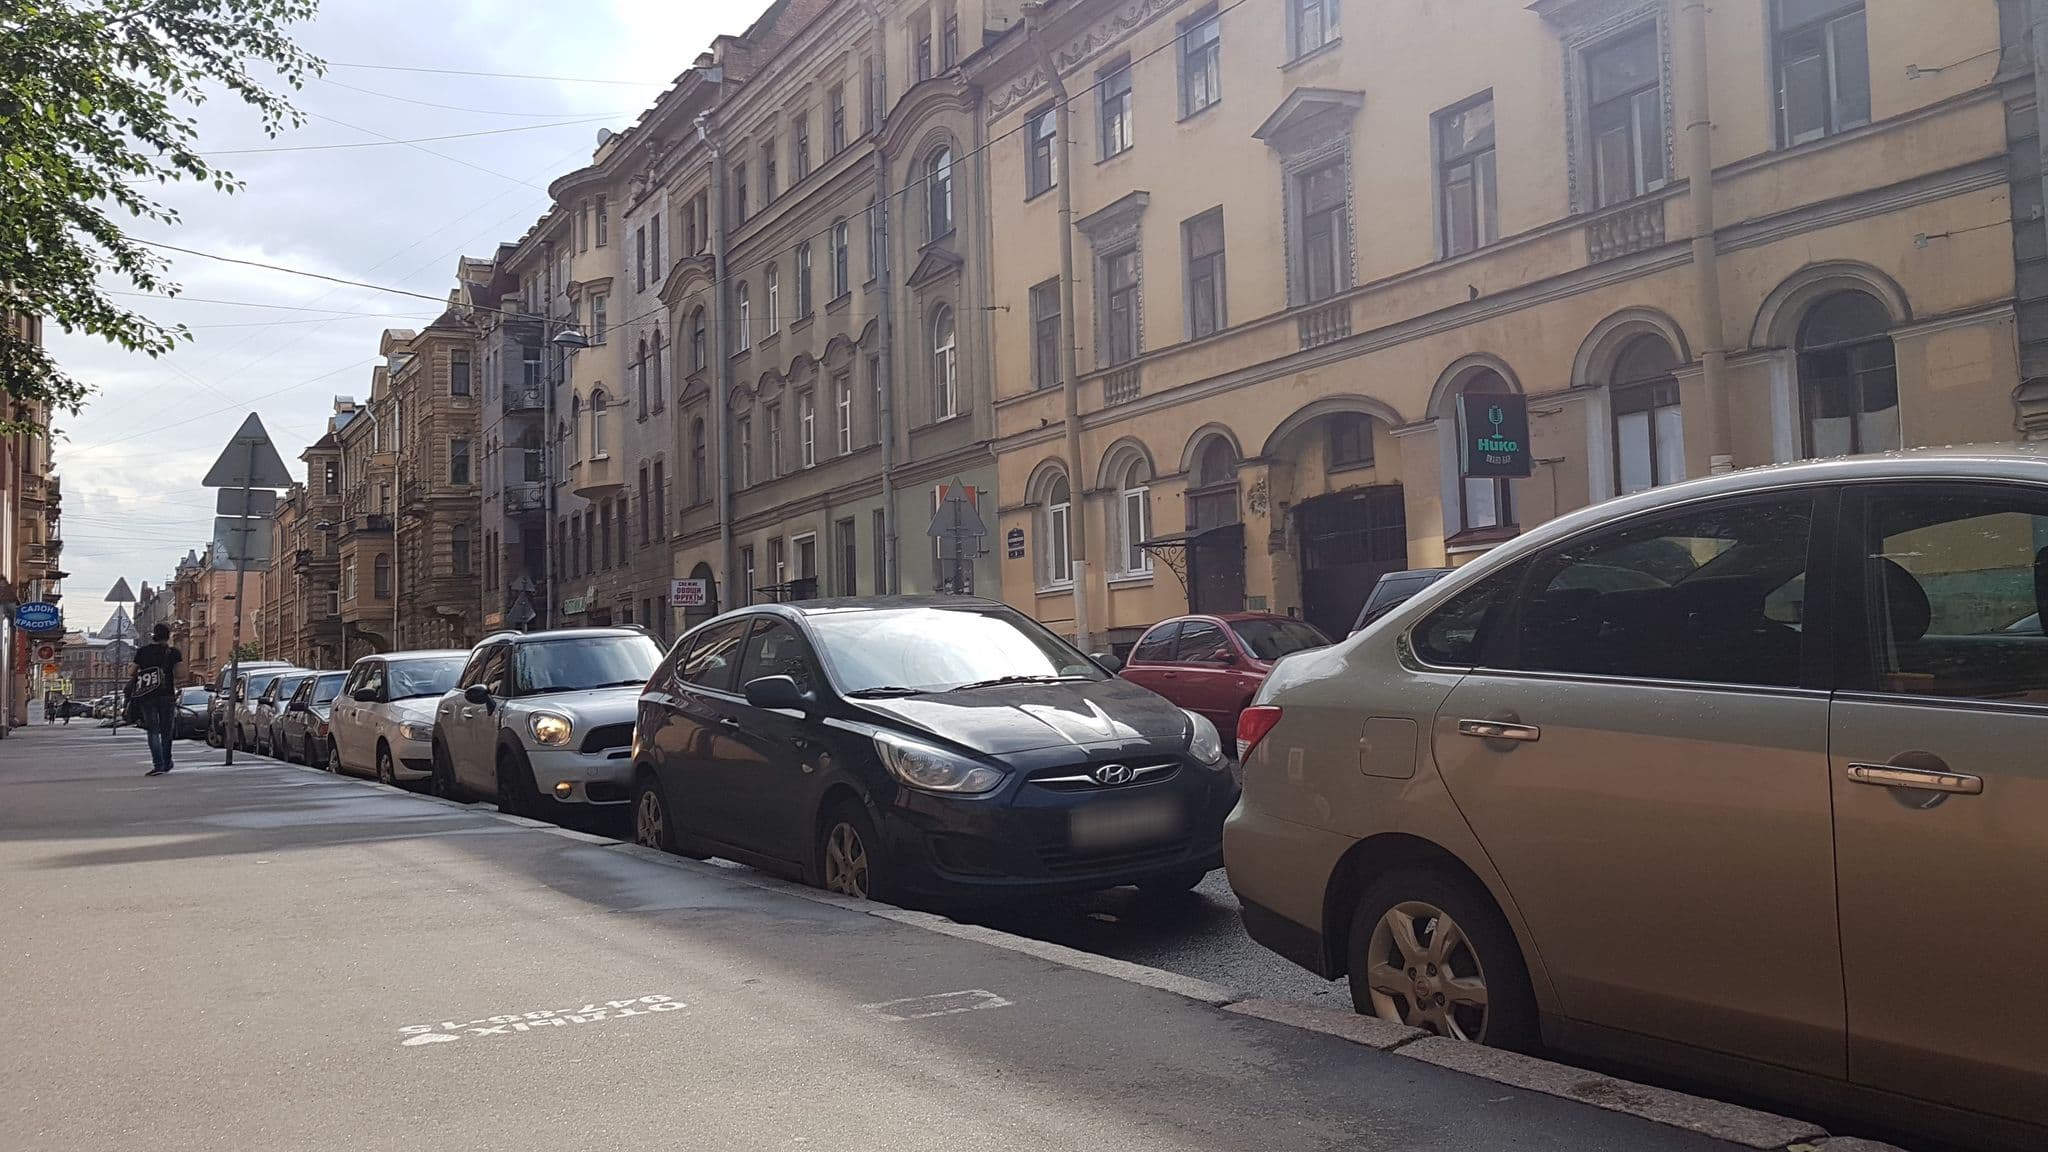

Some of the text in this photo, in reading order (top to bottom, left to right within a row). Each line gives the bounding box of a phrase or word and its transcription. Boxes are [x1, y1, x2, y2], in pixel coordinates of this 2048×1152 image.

[20, 605, 54, 614] САЛОН
[15, 618, 58, 628] КРАСОТЫ
[466, 1001, 687, 1037] ОТДЫХ
